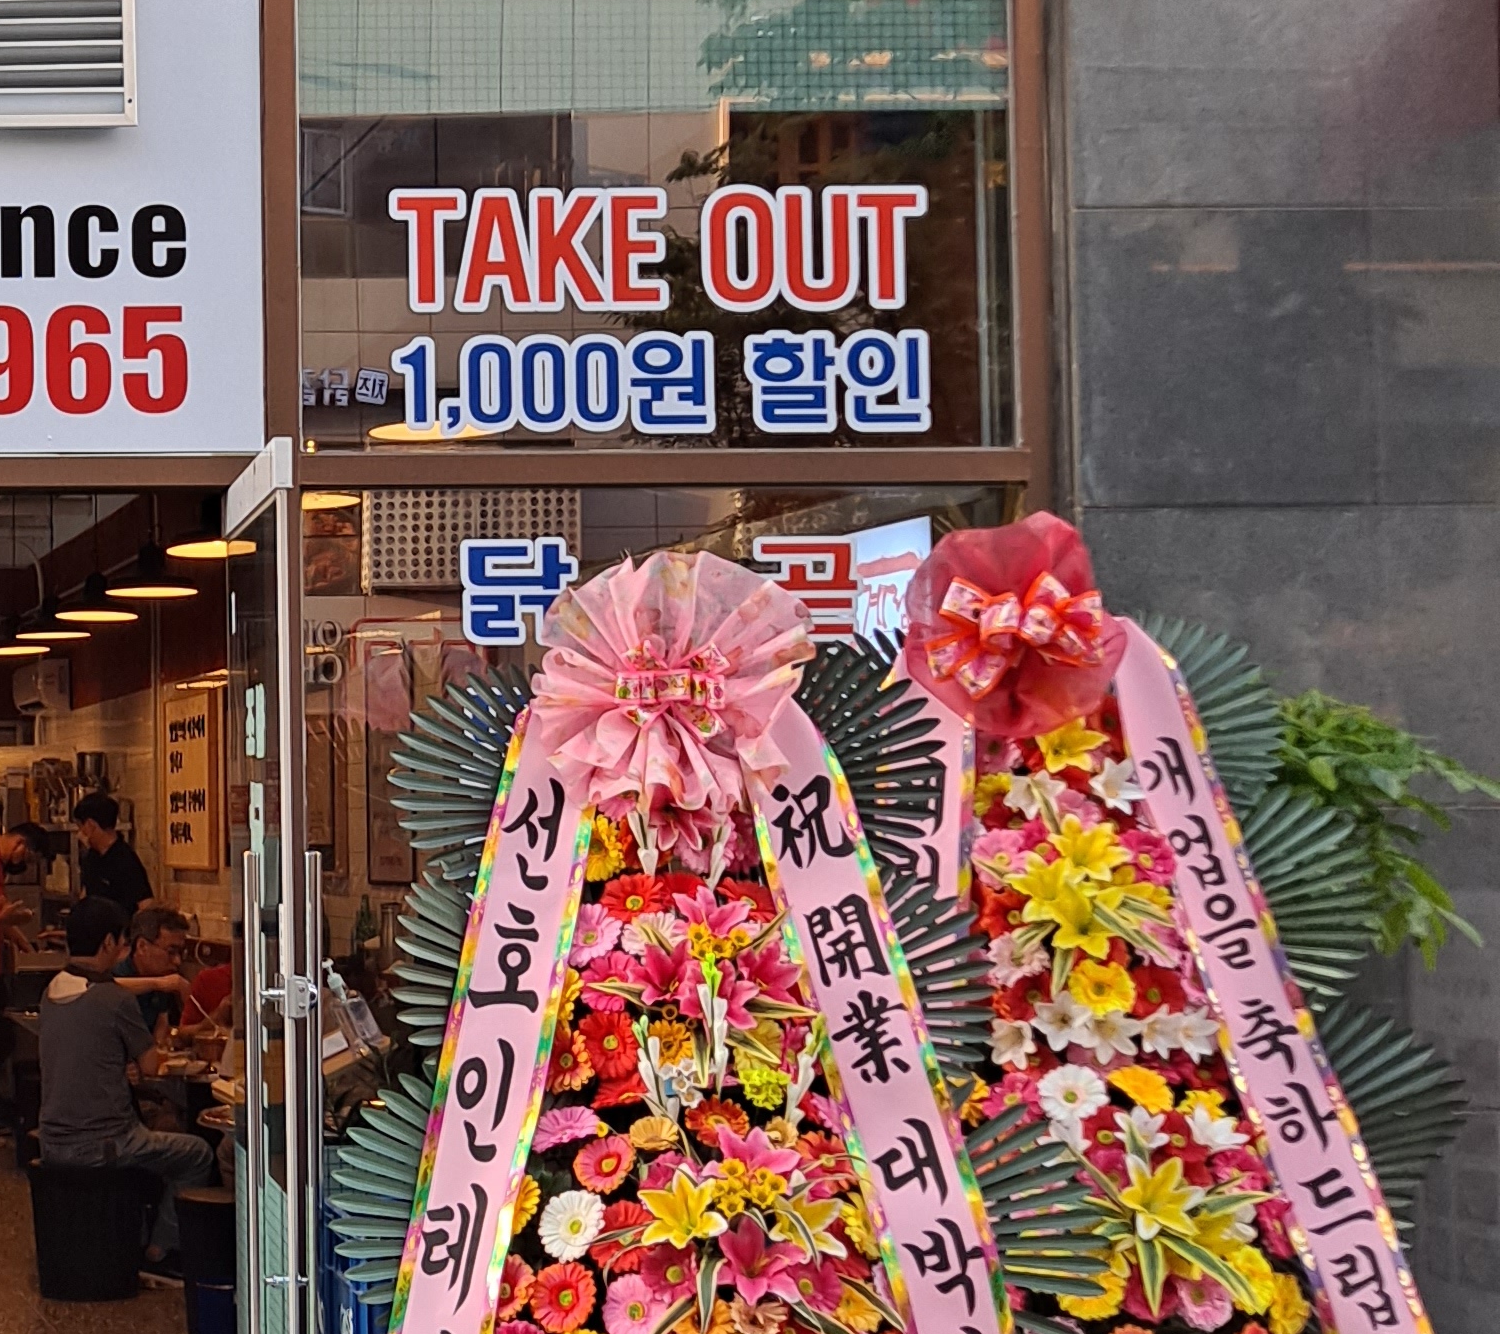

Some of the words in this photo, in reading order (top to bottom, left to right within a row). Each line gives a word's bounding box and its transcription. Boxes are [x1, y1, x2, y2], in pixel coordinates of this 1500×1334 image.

[390, 187, 670, 312] TAKE
[700, 184, 928, 313] OUT
[392, 330, 716, 434] 1,000원
[744, 329, 932, 434] 할인
